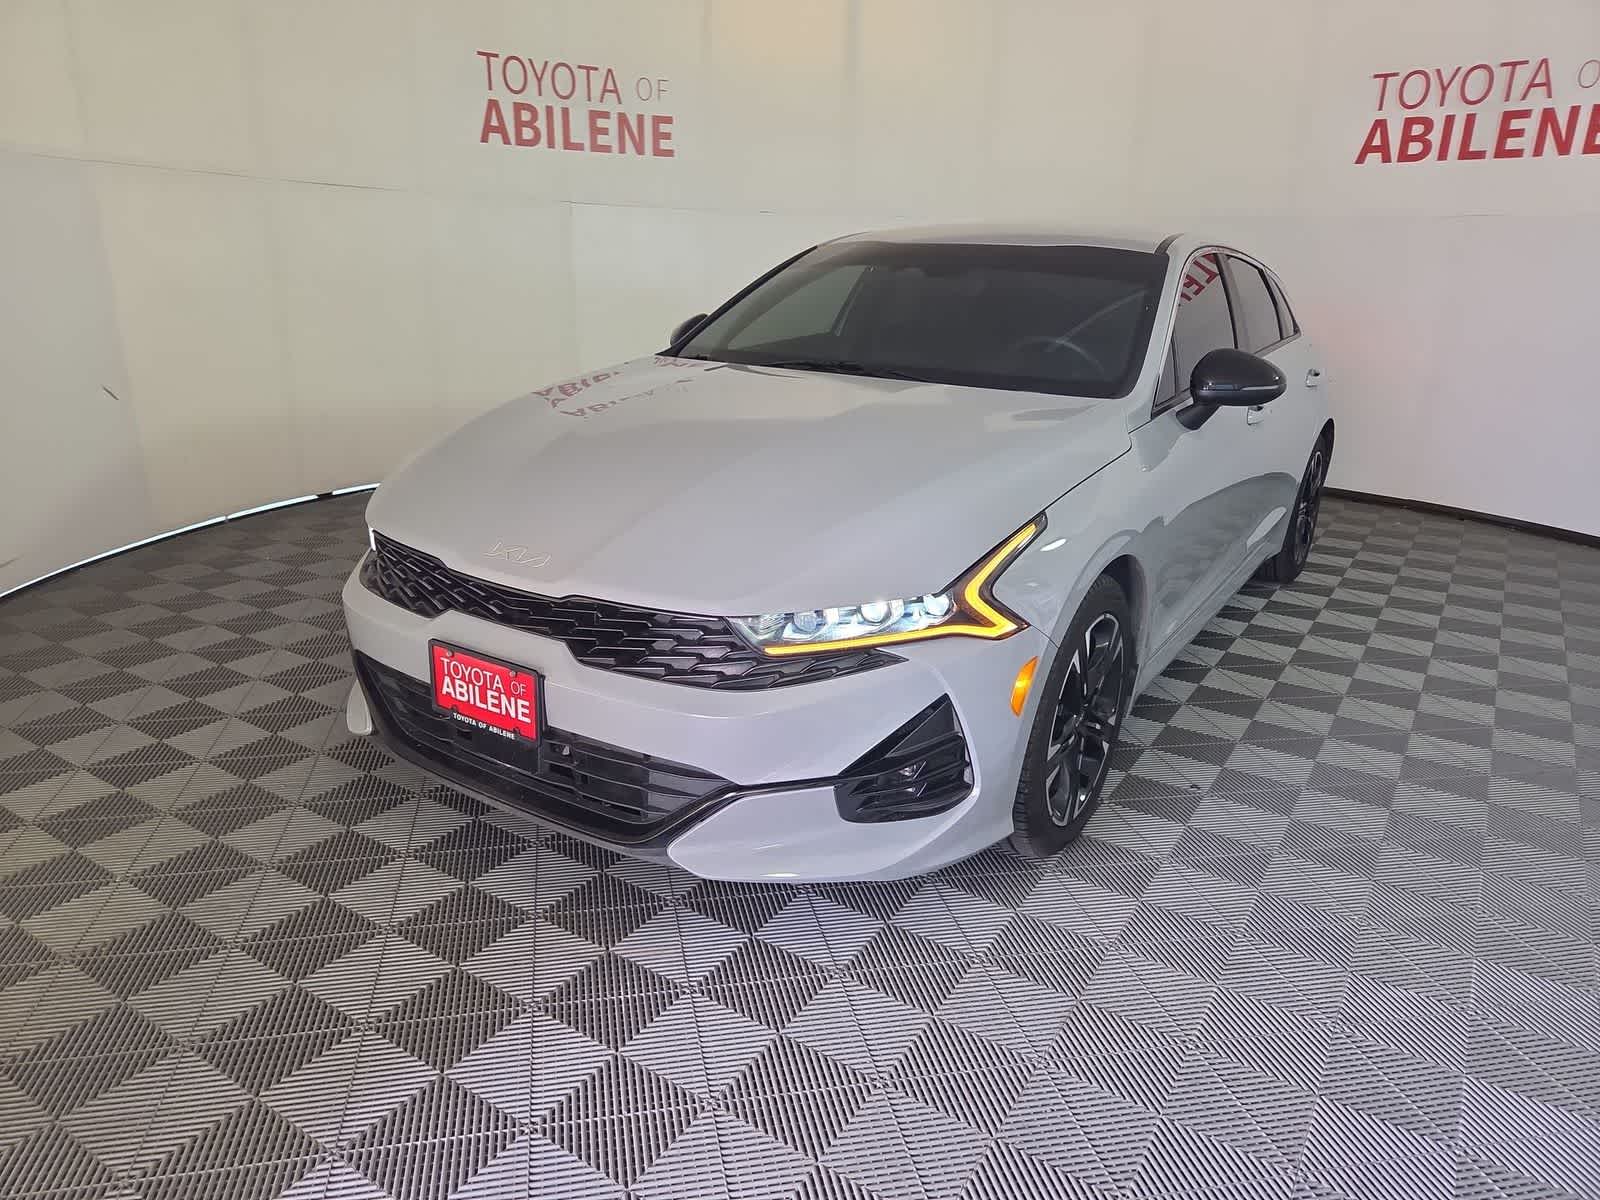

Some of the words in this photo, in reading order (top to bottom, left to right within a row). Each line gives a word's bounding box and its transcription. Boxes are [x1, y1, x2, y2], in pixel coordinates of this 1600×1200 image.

[476, 50, 623, 105] TOYOTA
[636, 76, 669, 102] OF
[1372, 57, 1553, 112] TOYOTA
[1577, 59, 1600, 89] O
[480, 98, 675, 158] ABILENE
[440, 656, 505, 693] TOYOTA
[510, 680, 527, 697] OF
[441, 675, 532, 724] ABILENE
[452, 712, 477, 727] TOYOTA
[478, 721, 487, 729] OF
[488, 725, 516, 740] ABILENE
